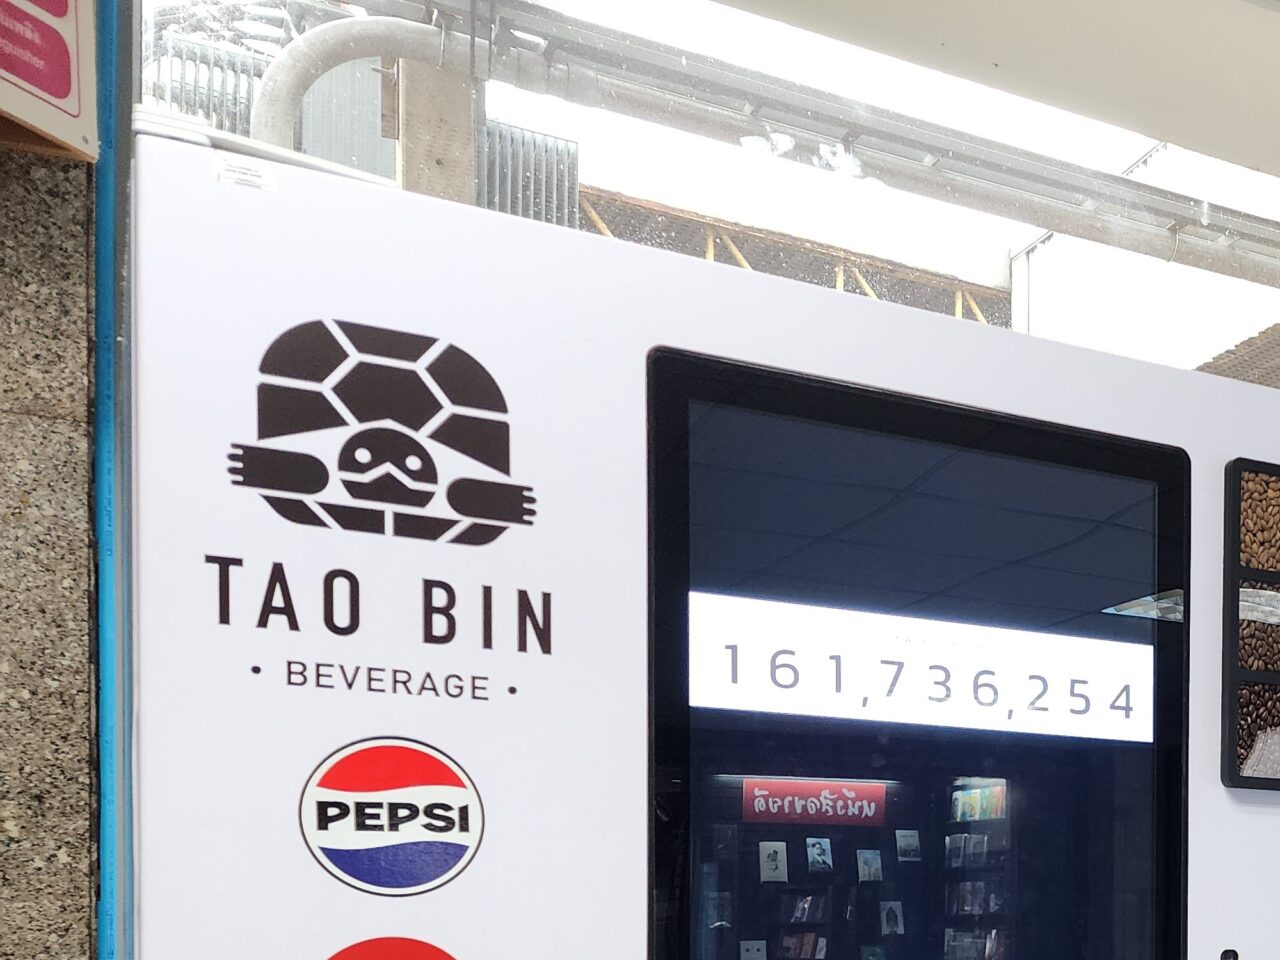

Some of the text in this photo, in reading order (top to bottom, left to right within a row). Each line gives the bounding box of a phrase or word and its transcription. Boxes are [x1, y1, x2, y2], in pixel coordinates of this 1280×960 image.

[205, 554, 552, 655] TAO BIN
[286, 661, 490, 701] BEVERAGE
[724, 644, 1134, 719] 161,736,254
[316, 800, 470, 833] PEPSI
